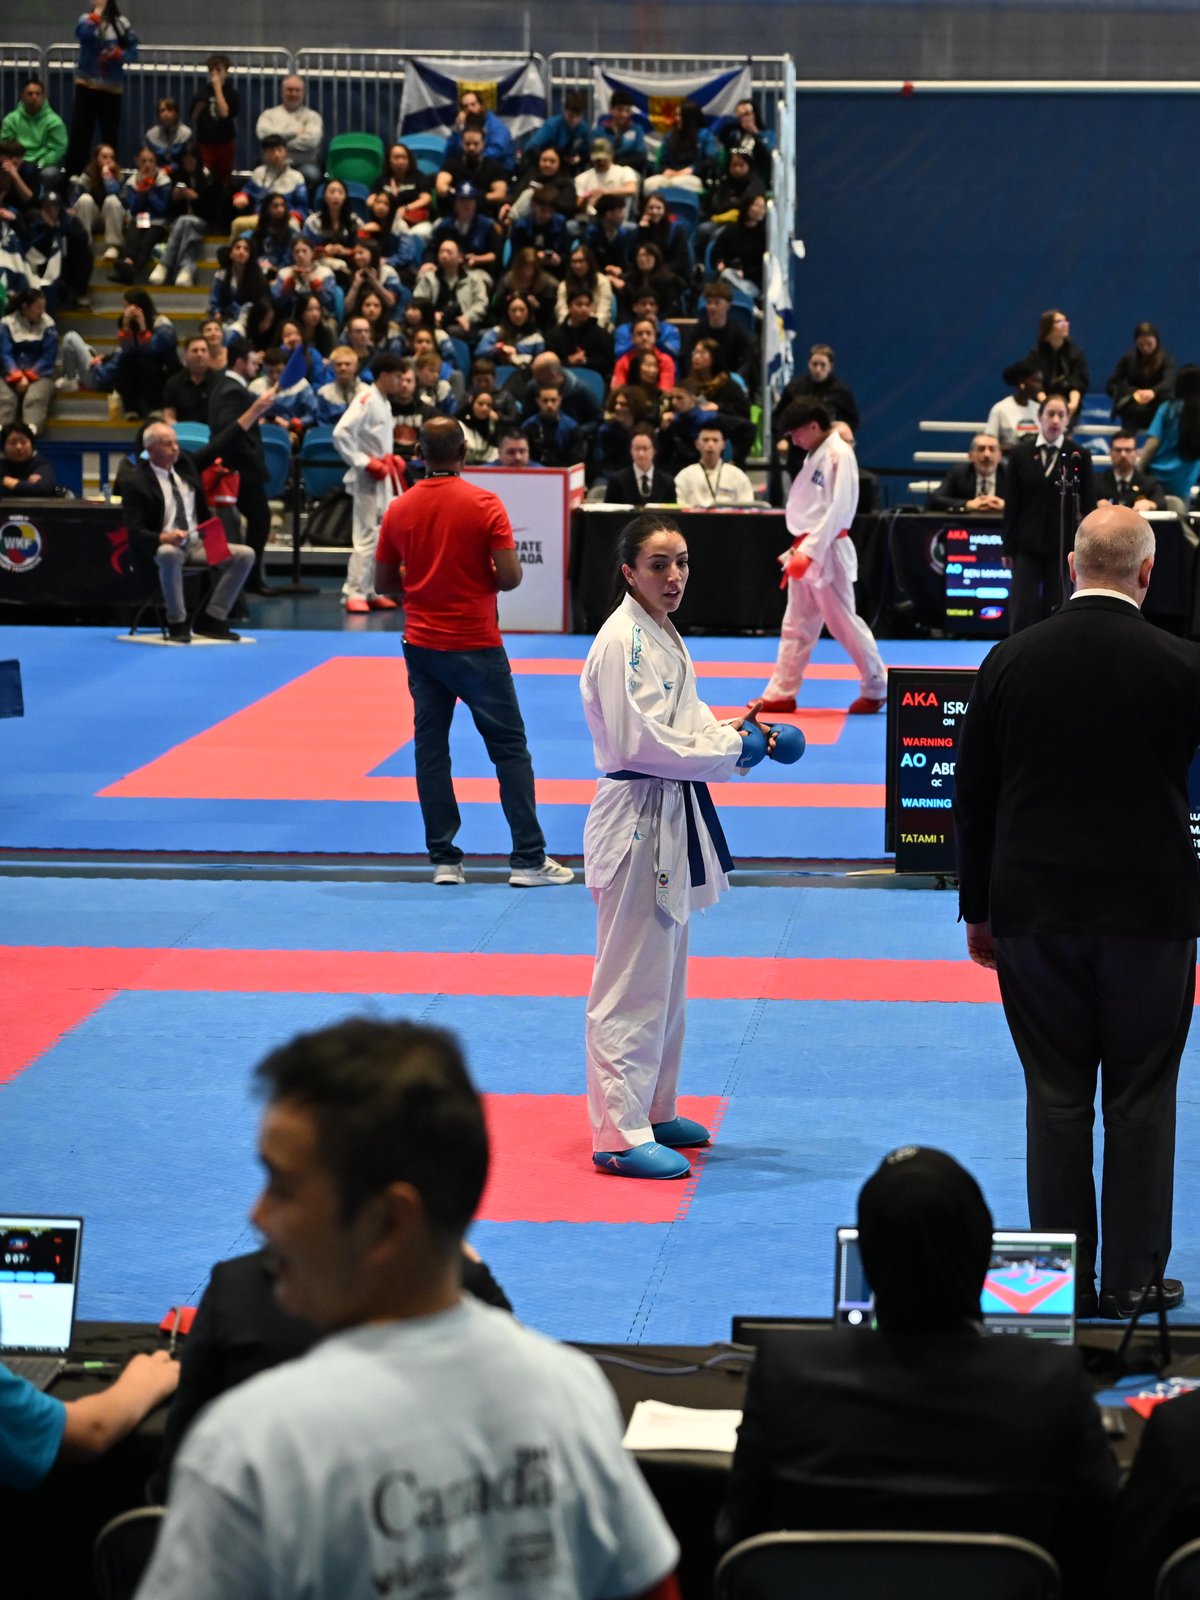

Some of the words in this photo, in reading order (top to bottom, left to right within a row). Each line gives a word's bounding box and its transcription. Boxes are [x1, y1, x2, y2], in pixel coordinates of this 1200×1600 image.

[902, 692, 938, 706] AKA
[942, 718, 955, 726] ON
[902, 737, 953, 748] WARNING
[900, 752, 927, 768] AO
[931, 779, 943, 787] QC
[901, 798, 952, 808] WARNING
[900, 834, 936, 843] TATAMI
[940, 834, 944, 843] 1
